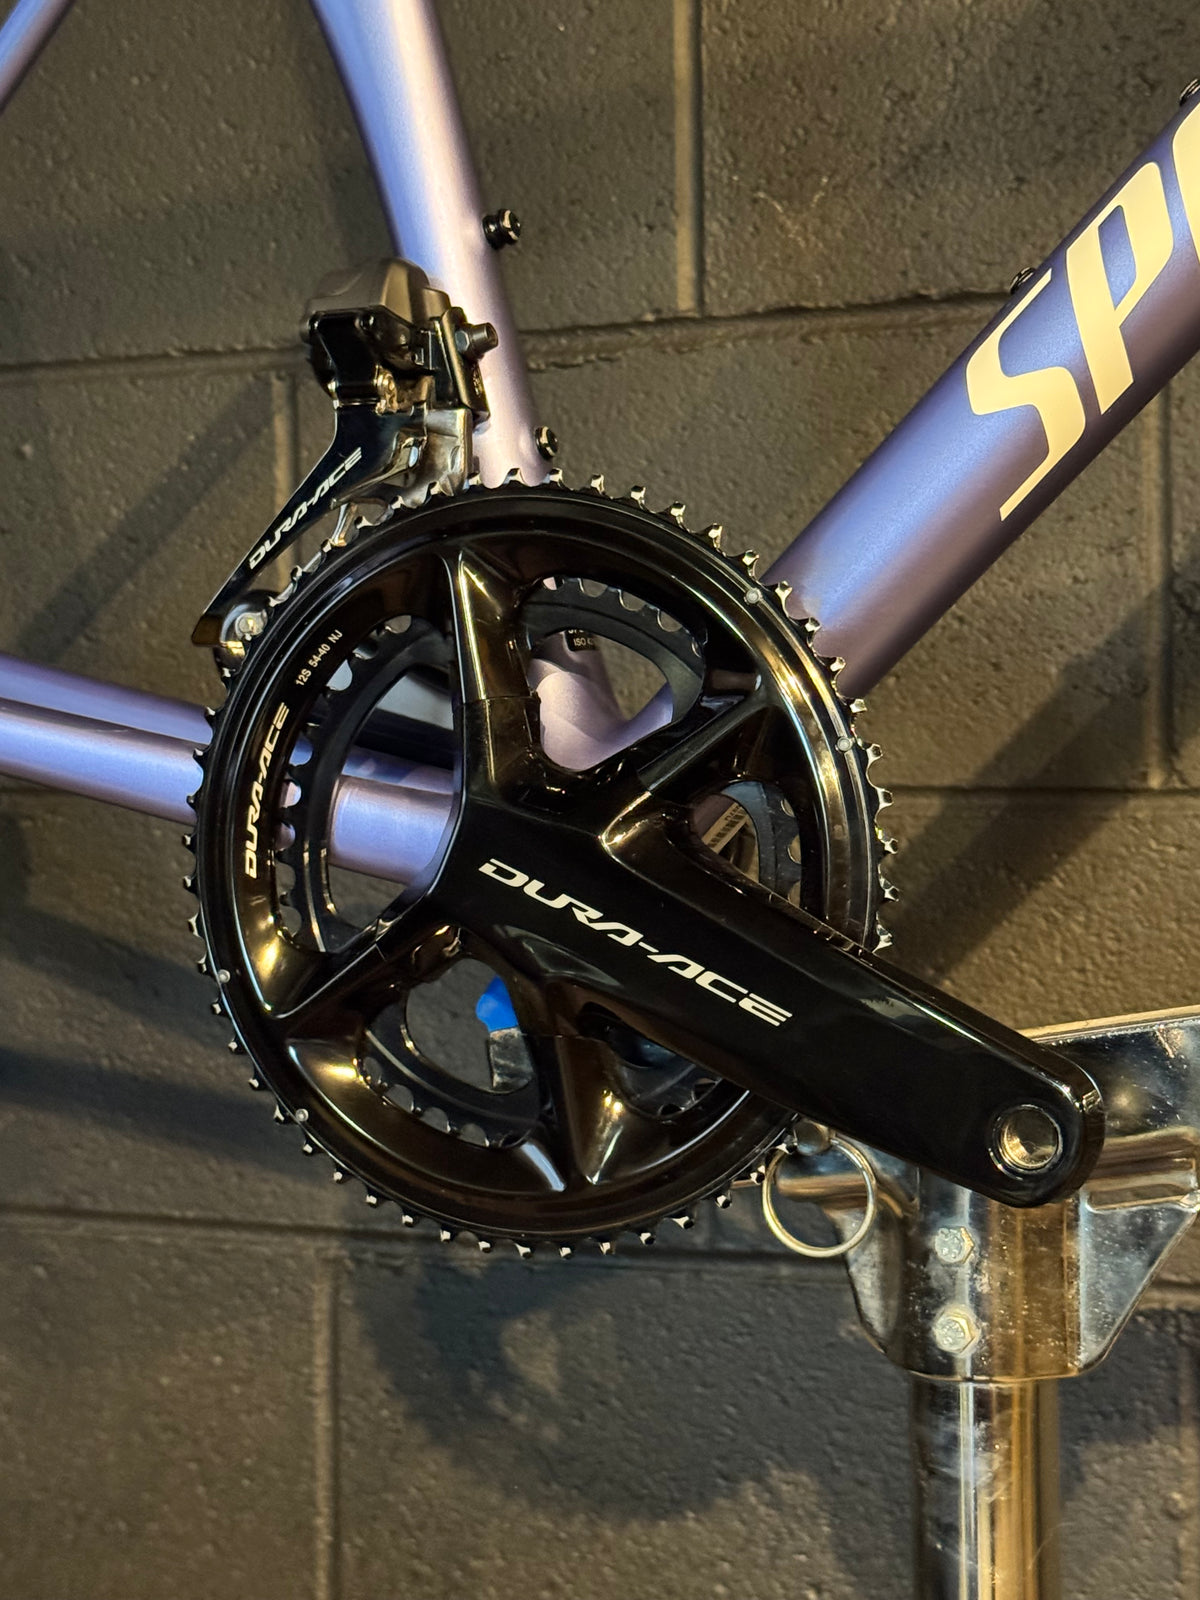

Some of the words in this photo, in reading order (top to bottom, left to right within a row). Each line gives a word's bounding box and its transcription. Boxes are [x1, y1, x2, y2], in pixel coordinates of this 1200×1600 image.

[249, 446, 362, 570] DURA-ACE
[295, 668, 312, 686] 12S
[308, 643, 331, 668] 54-40
[327, 629, 343, 644] NJ
[245, 701, 290, 879] DURA-ACE
[478, 858, 793, 1027] DURA-ACE
